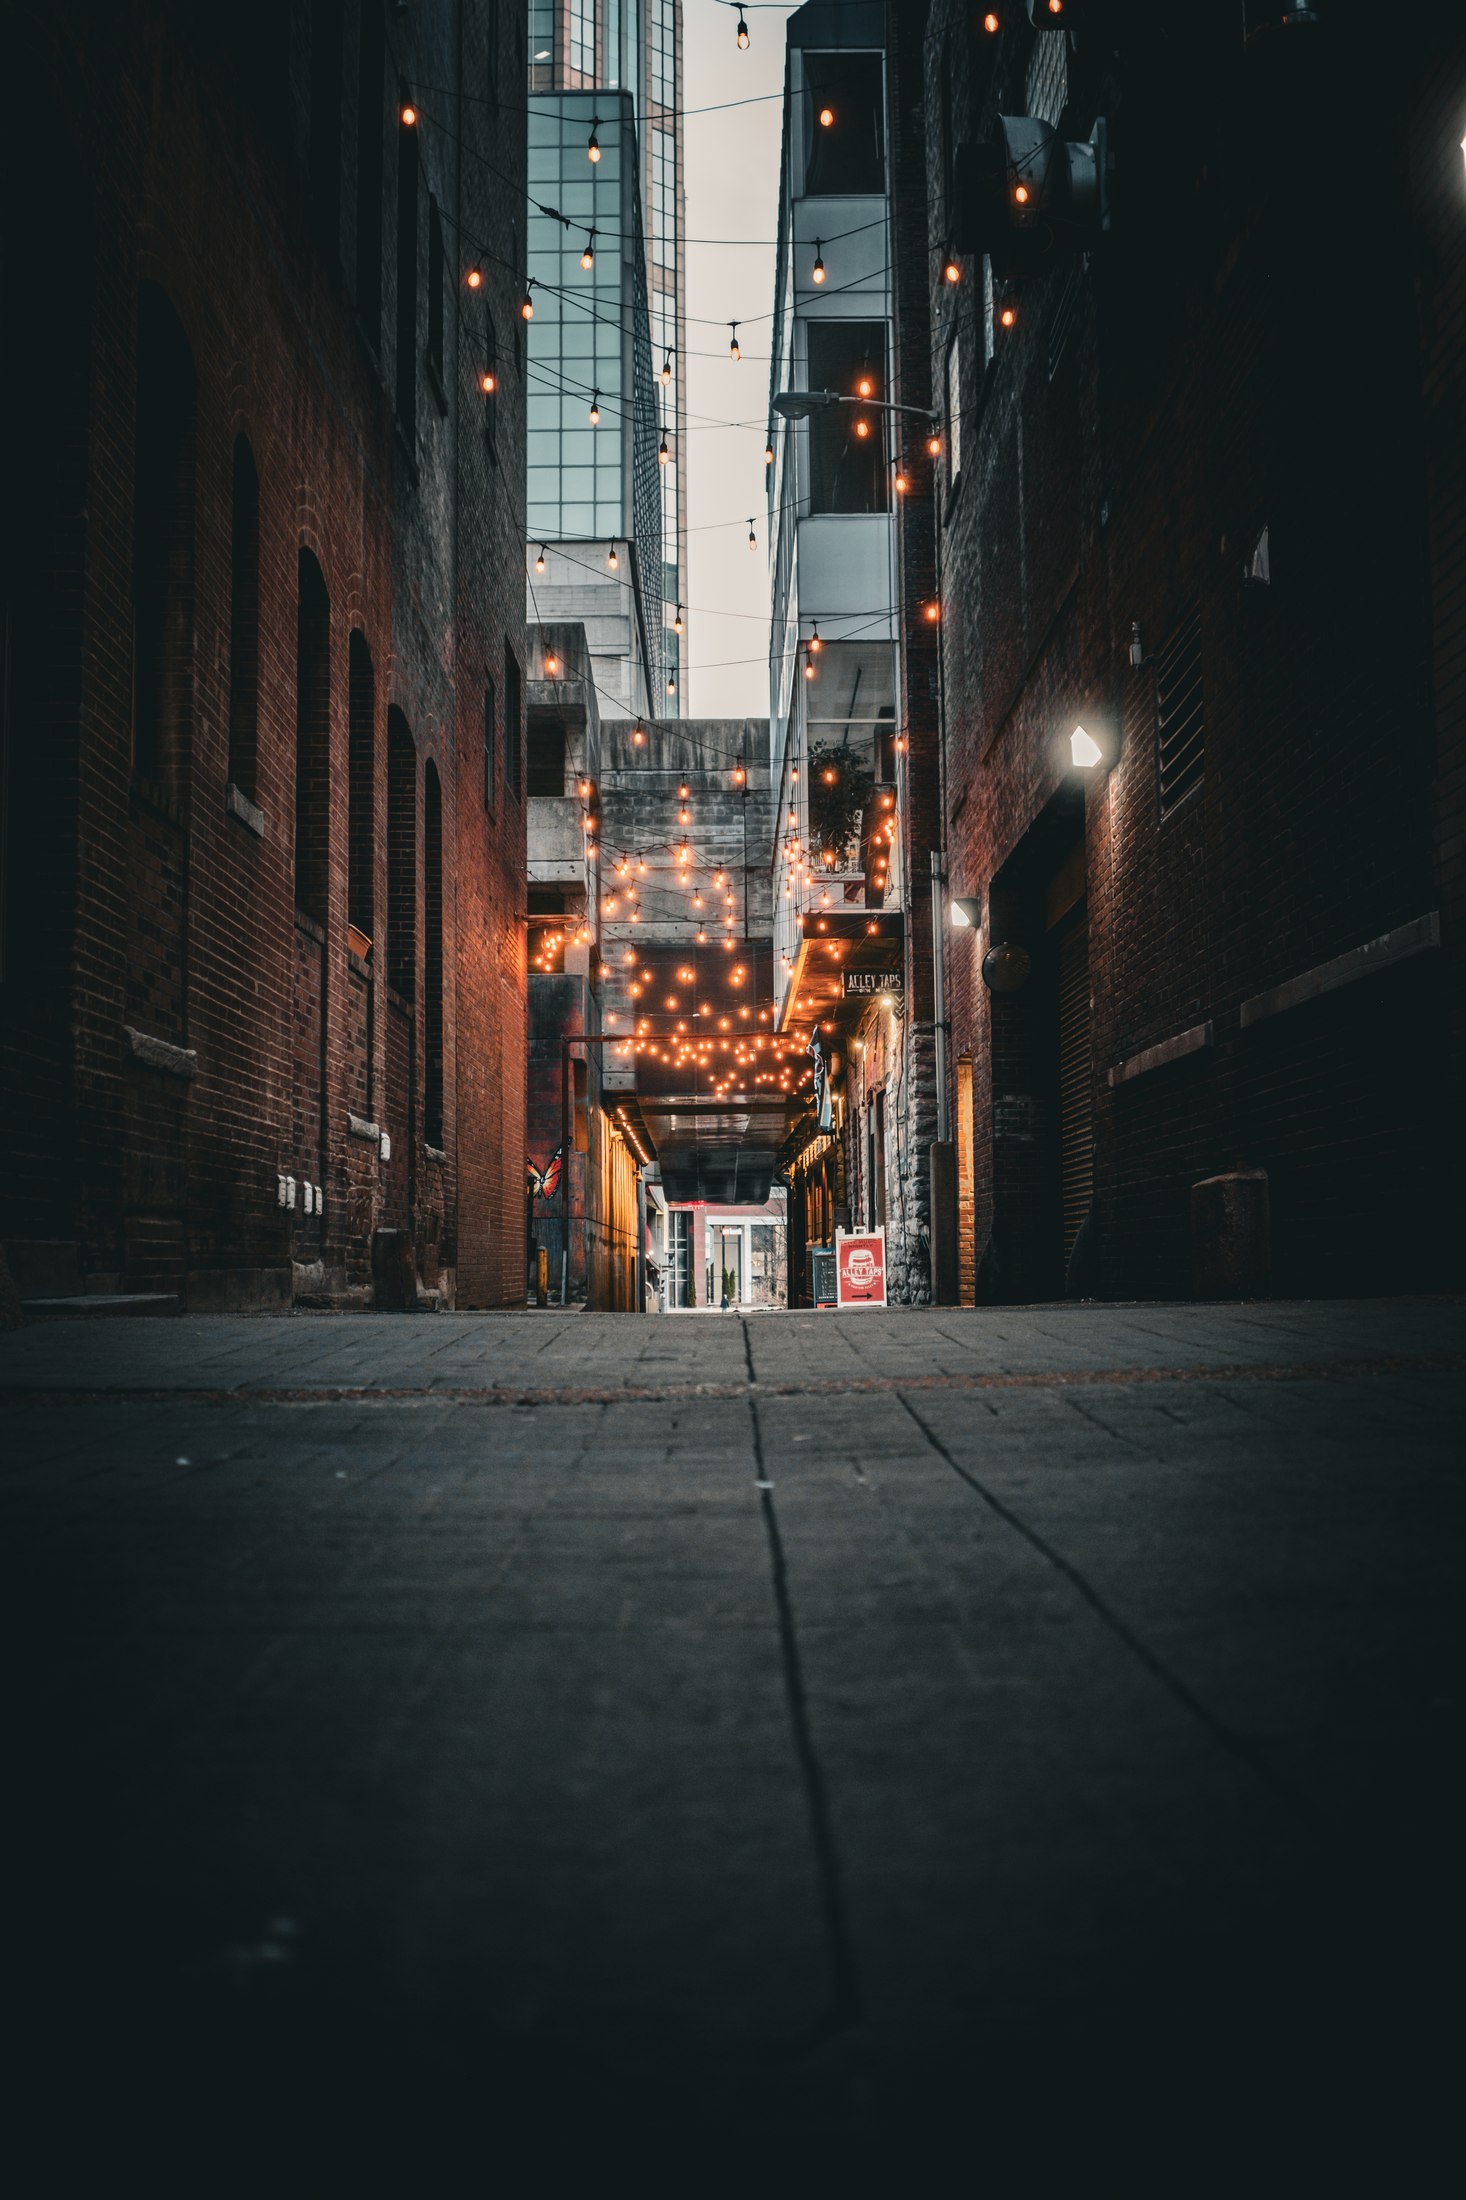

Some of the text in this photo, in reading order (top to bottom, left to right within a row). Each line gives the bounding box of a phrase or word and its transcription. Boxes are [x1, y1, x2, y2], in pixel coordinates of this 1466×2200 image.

[848, 974, 901, 988] ALLEY TAPS
[842, 1268, 882, 1277] ALLEY TAPS
